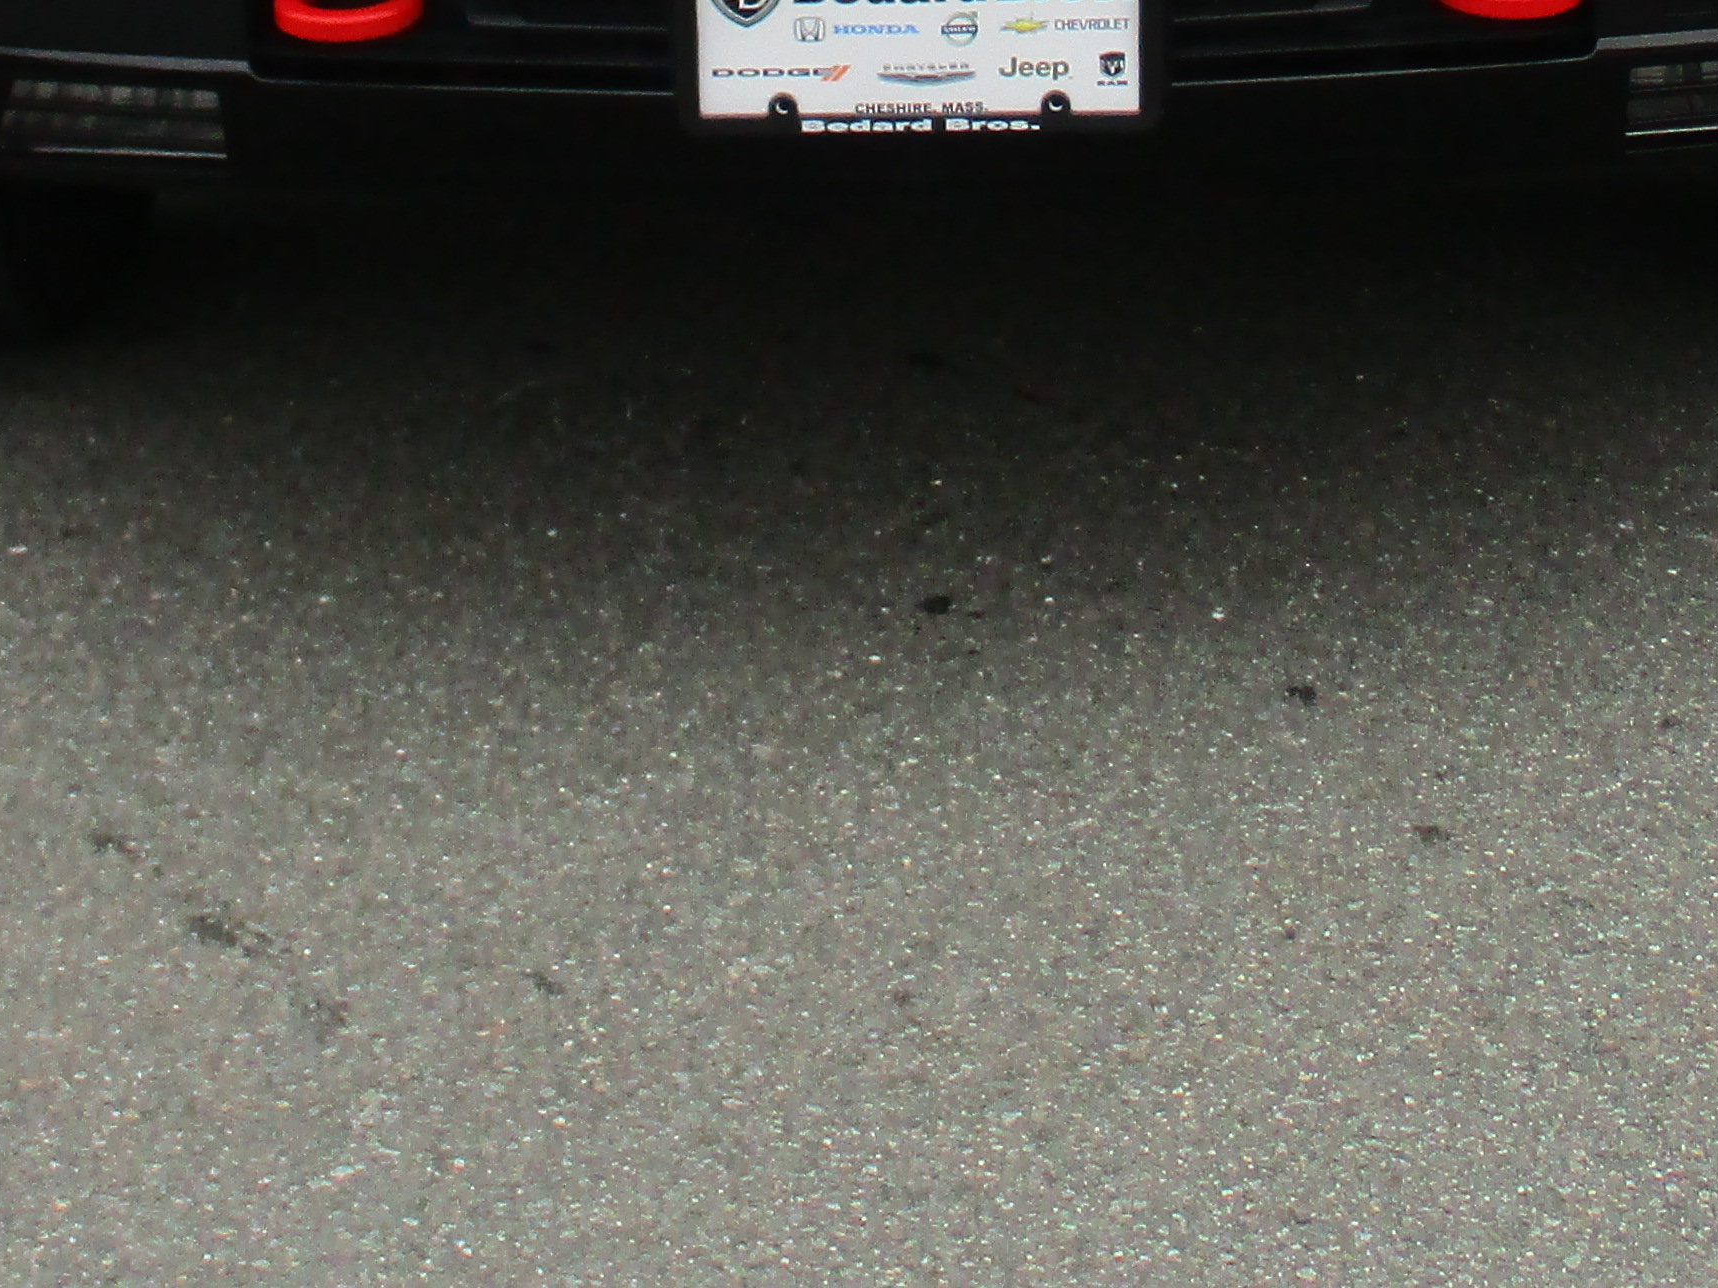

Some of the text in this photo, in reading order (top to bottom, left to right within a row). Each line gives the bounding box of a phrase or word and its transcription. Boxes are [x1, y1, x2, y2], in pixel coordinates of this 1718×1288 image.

[834, 24, 920, 35] HONDA
[1054, 18, 1131, 31] CHEVROLET
[712, 68, 831, 78] DODGE
[998, 56, 1071, 81] Jeep
[801, 118, 1041, 133] Bedard Bros.
